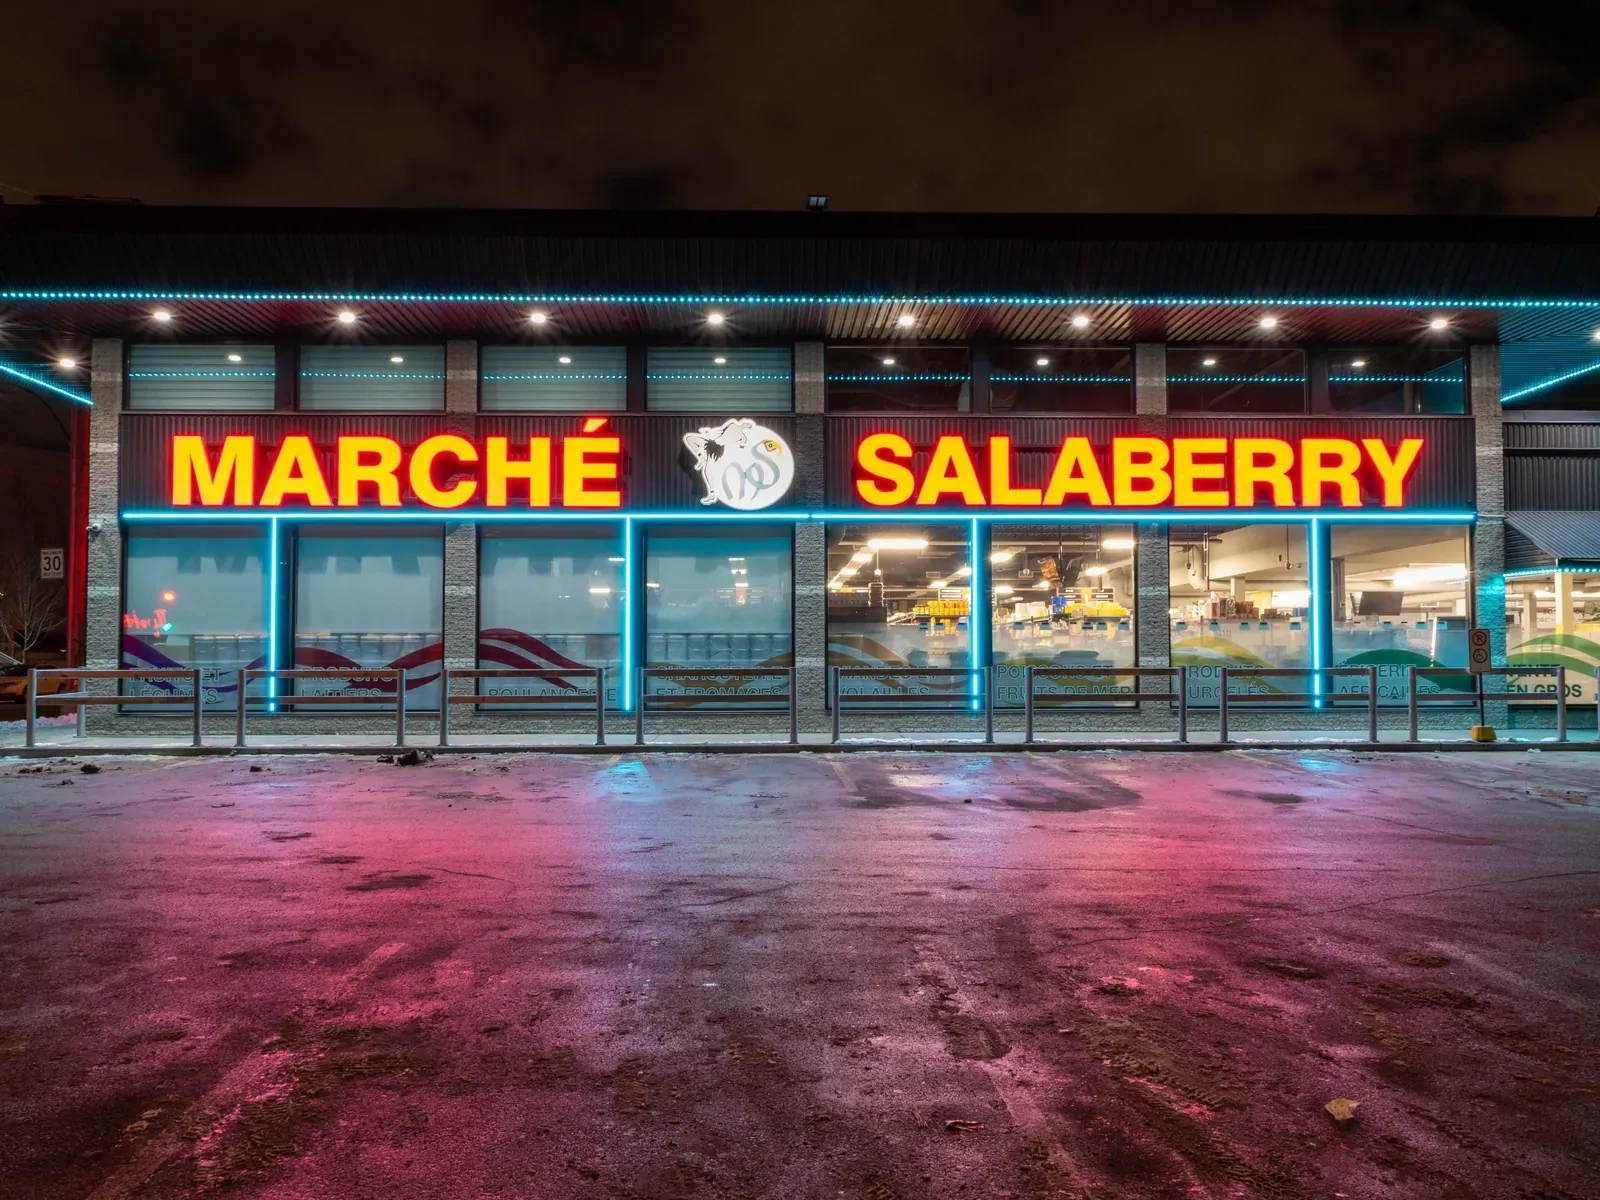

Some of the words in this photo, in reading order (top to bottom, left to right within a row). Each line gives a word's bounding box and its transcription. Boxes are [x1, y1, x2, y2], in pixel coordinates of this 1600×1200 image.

[171, 417, 622, 508] MARCHÉ
[855, 431, 1425, 508] SALABERRY
[43, 556, 61, 571] 30
